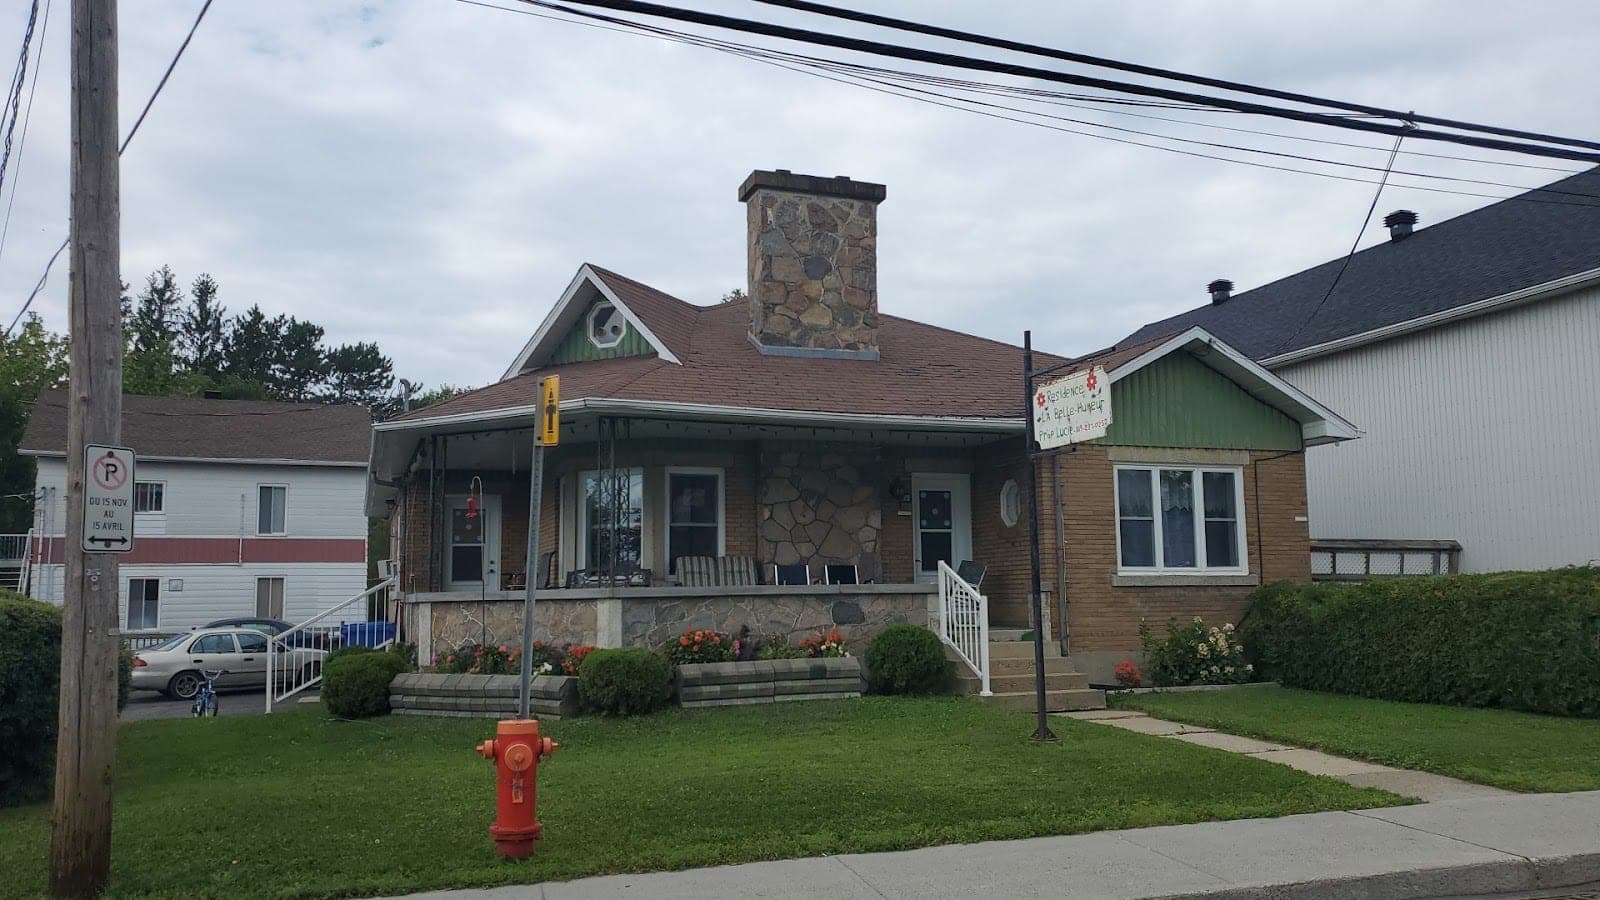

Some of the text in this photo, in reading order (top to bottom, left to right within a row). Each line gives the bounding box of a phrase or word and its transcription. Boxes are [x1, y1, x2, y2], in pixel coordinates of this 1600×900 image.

[105, 463, 118, 481] P
[89, 497, 100, 506] DU
[103, 497, 110, 506] 15
[103, 510, 114, 518] AU
[92, 521, 124, 530] 15 AVRIL
